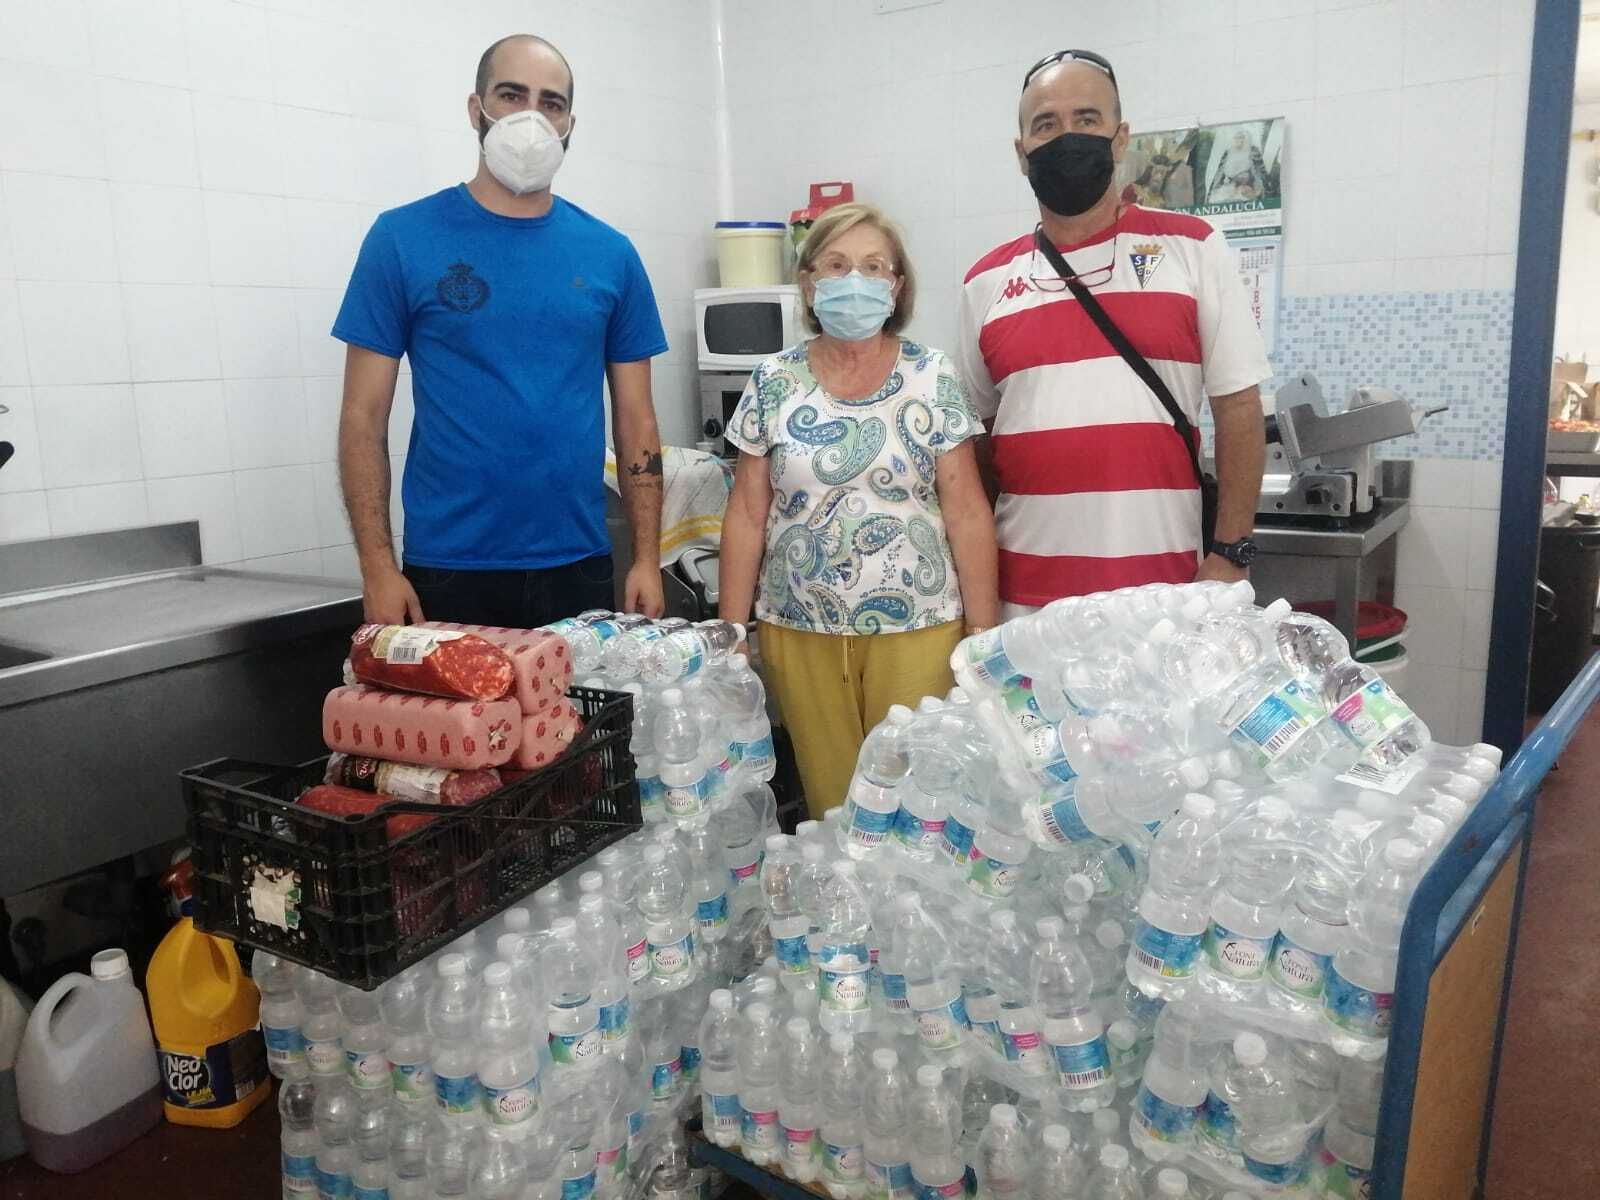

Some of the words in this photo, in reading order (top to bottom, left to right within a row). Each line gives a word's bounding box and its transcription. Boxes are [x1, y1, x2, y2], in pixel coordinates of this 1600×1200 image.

[1194, 200, 1265, 216] ANDALUCÍA
[168, 1056, 201, 1074] Neo
[169, 1071, 203, 1090] Clor
